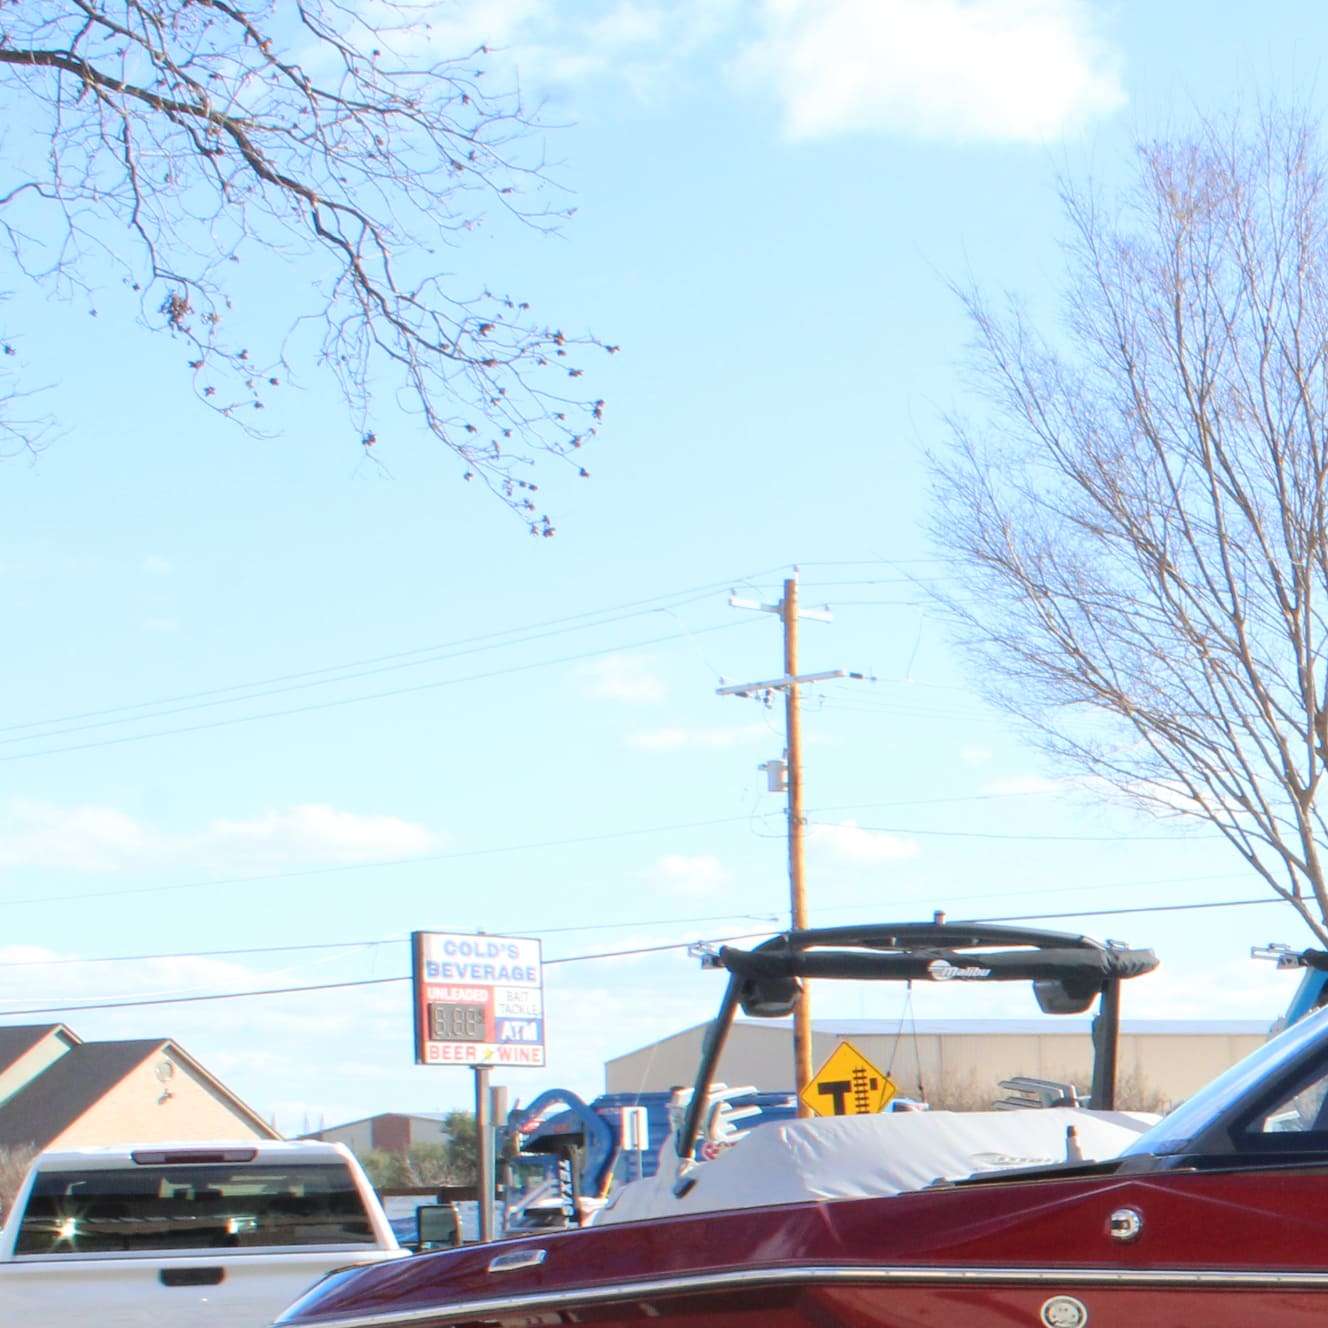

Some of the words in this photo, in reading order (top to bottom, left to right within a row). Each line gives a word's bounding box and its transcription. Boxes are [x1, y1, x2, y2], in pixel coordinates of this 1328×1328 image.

[427, 961, 536, 982] BEVERAGE
[427, 987, 489, 1002] UNLEADED
[500, 1020, 538, 1041] ATM
[428, 1045, 477, 1061] BEER
[497, 1046, 542, 1063] WINE
